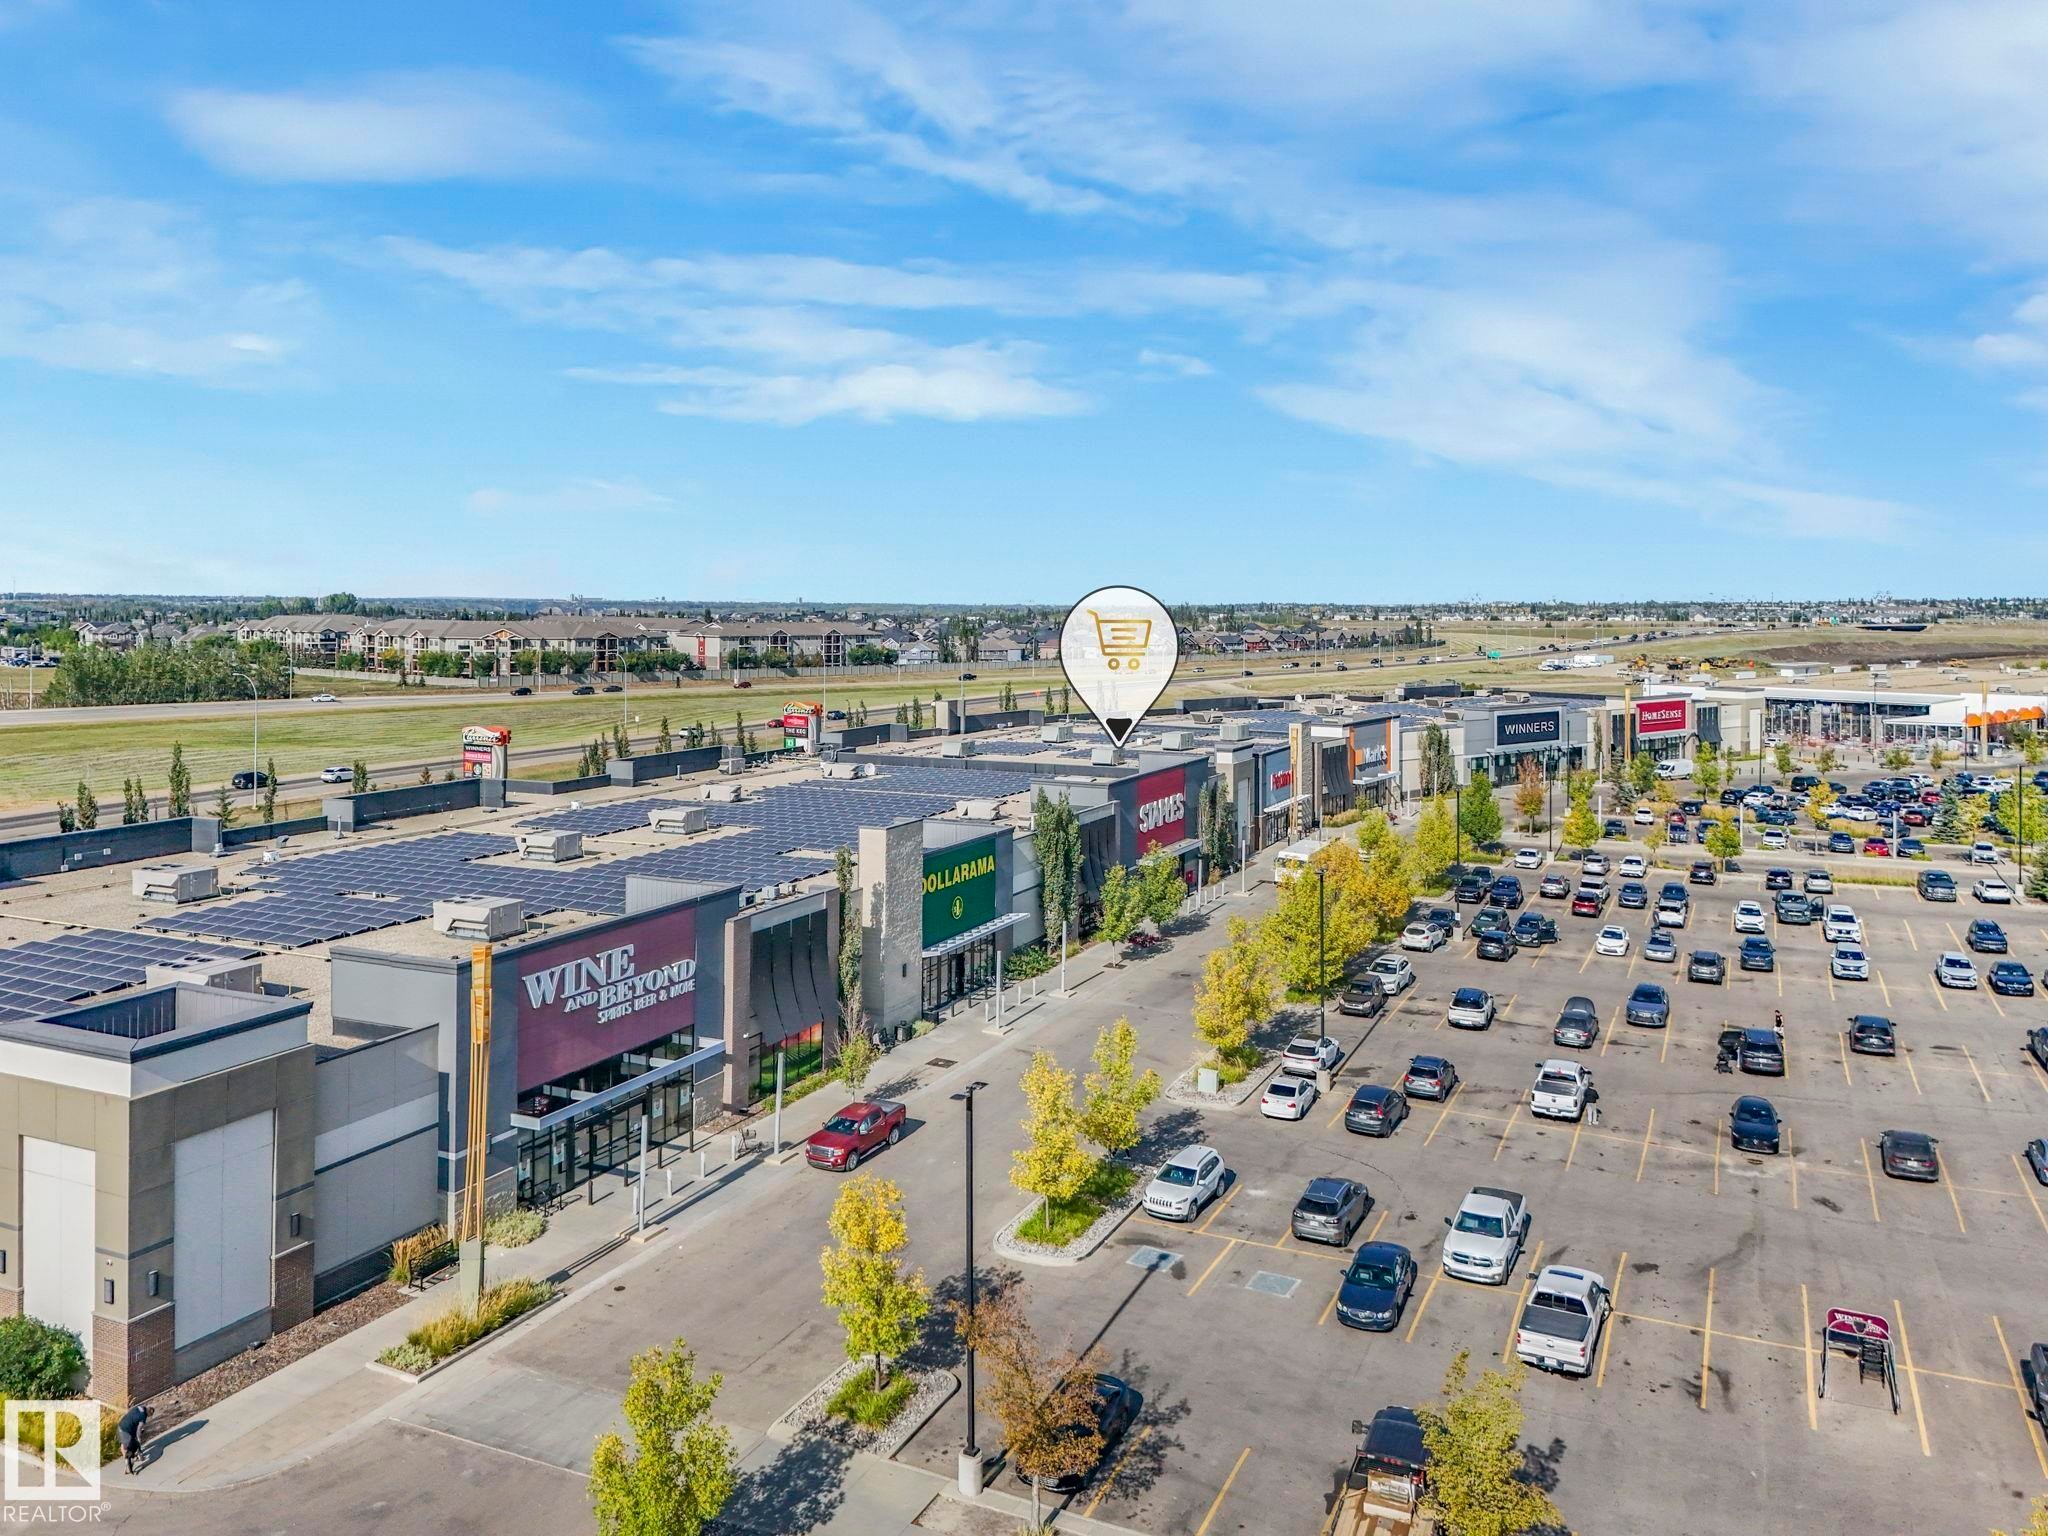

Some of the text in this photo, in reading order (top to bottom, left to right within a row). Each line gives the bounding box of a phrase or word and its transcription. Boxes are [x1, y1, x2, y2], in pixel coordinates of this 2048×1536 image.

[1505, 721, 1555, 735] WINNERS
[1140, 793, 1184, 833] STAPLES
[921, 855, 995, 895] DOLLARAMA
[521, 943, 635, 1009] WINE
[564, 958, 696, 1013] AND BEYOND
[597, 978, 696, 1024] SPIRITS BEER & MORE
